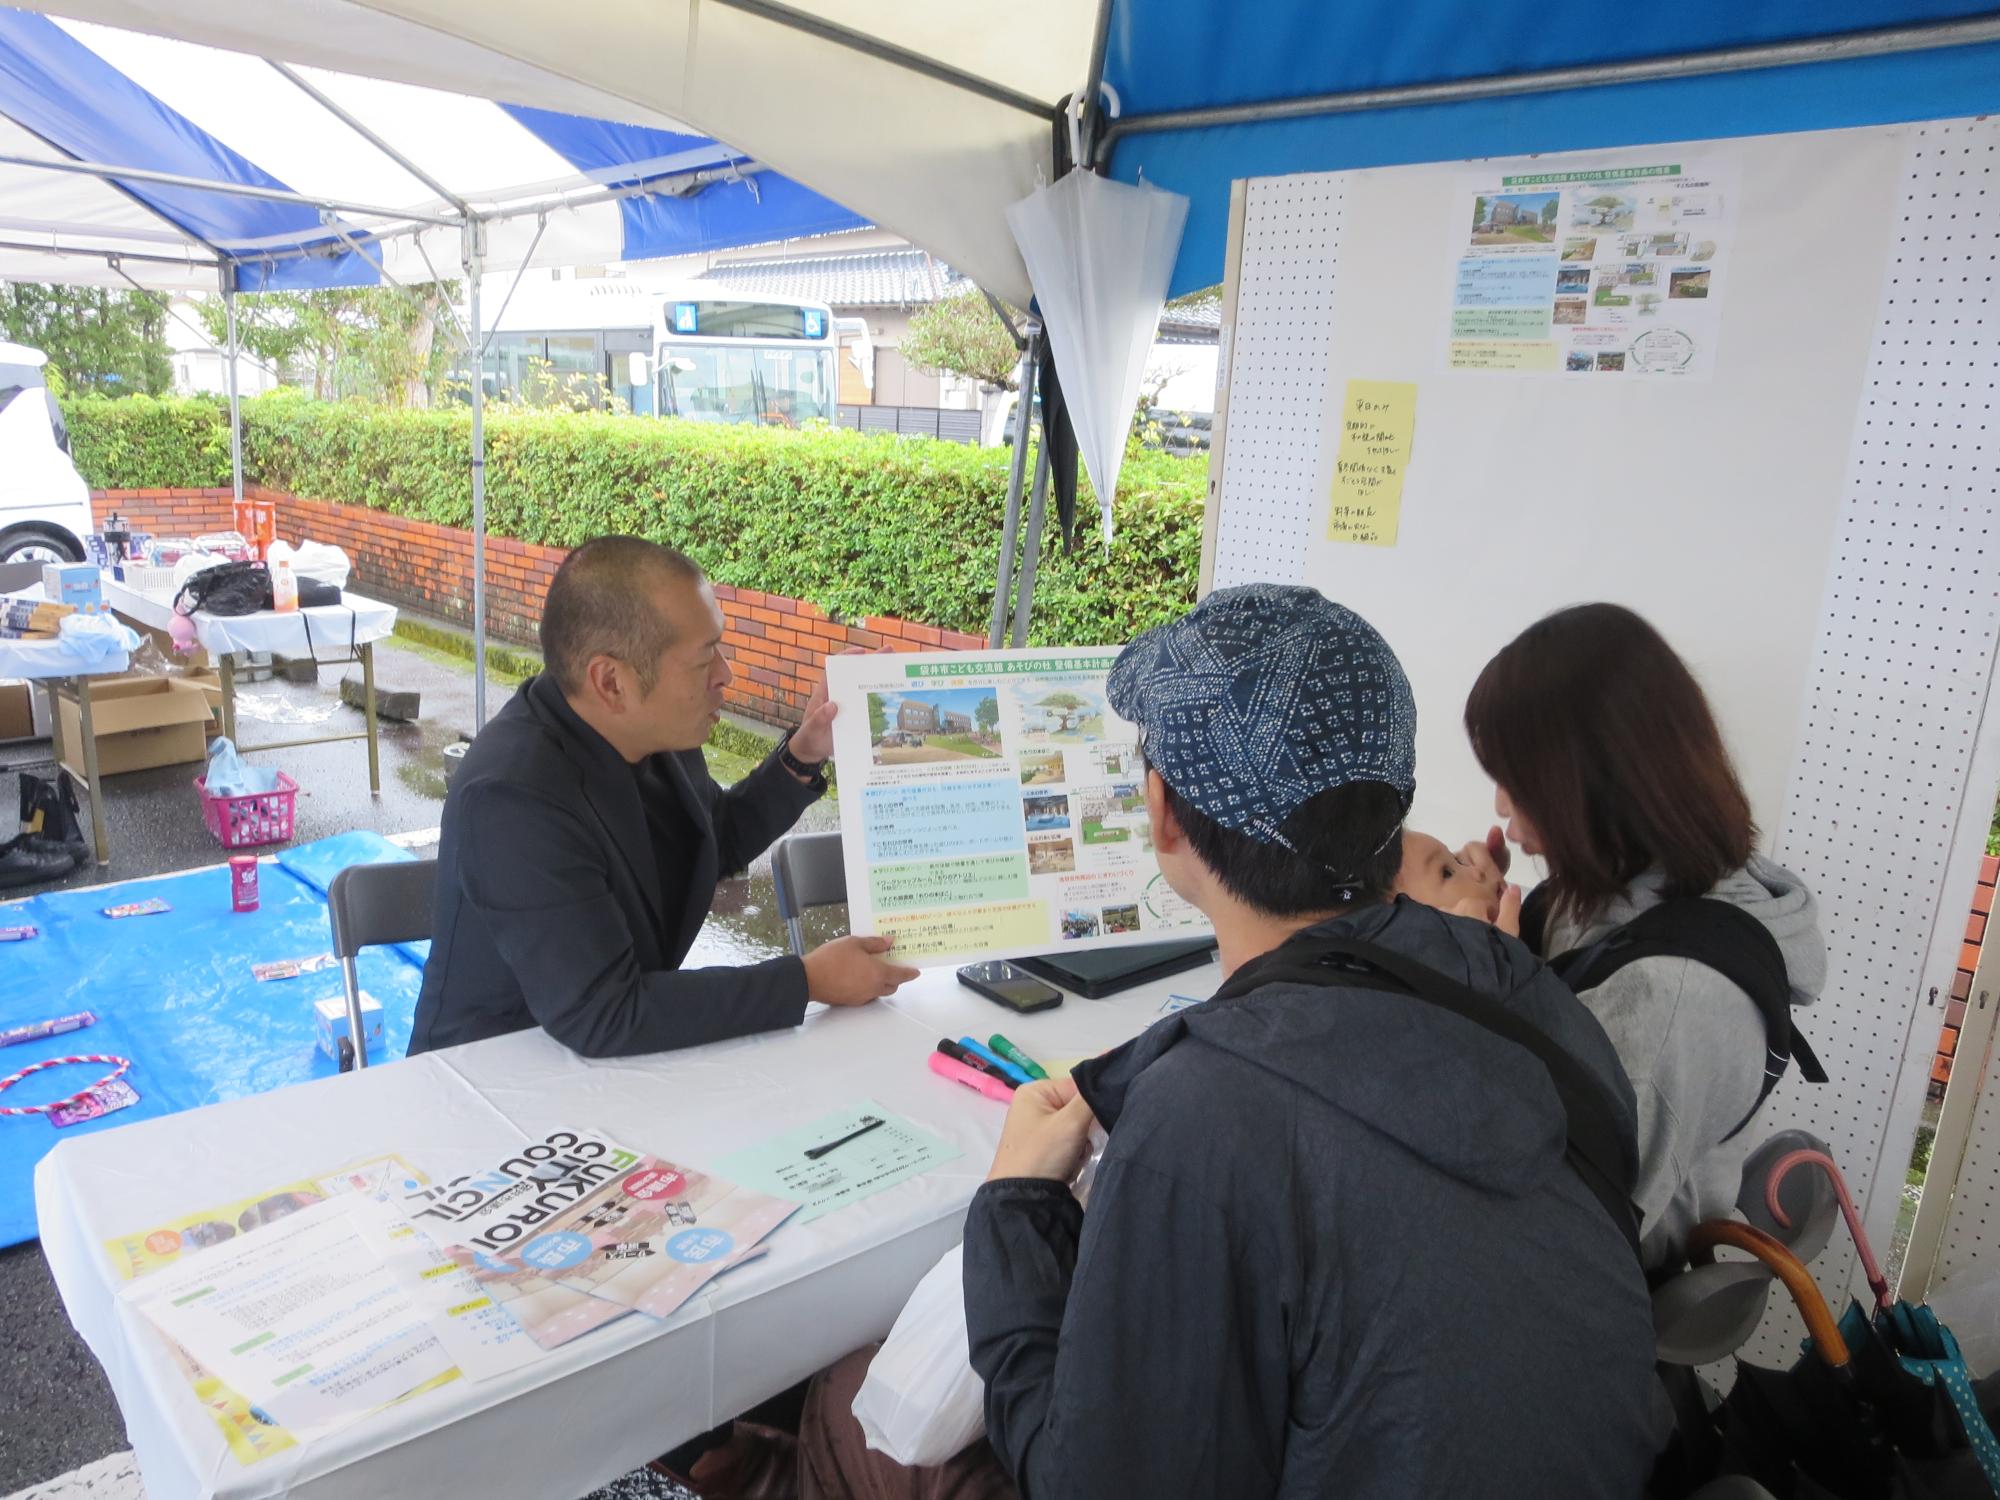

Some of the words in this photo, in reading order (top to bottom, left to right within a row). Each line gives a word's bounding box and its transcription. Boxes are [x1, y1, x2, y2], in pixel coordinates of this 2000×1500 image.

[919, 662, 1004, 676] 袋井市こども交流館
[1007, 661, 1052, 672] あそびの杜
[411, 1132, 579, 1222] COUNCIL
[470, 1148, 638, 1251] FUKUROI
[526, 1141, 606, 1194] CITY
